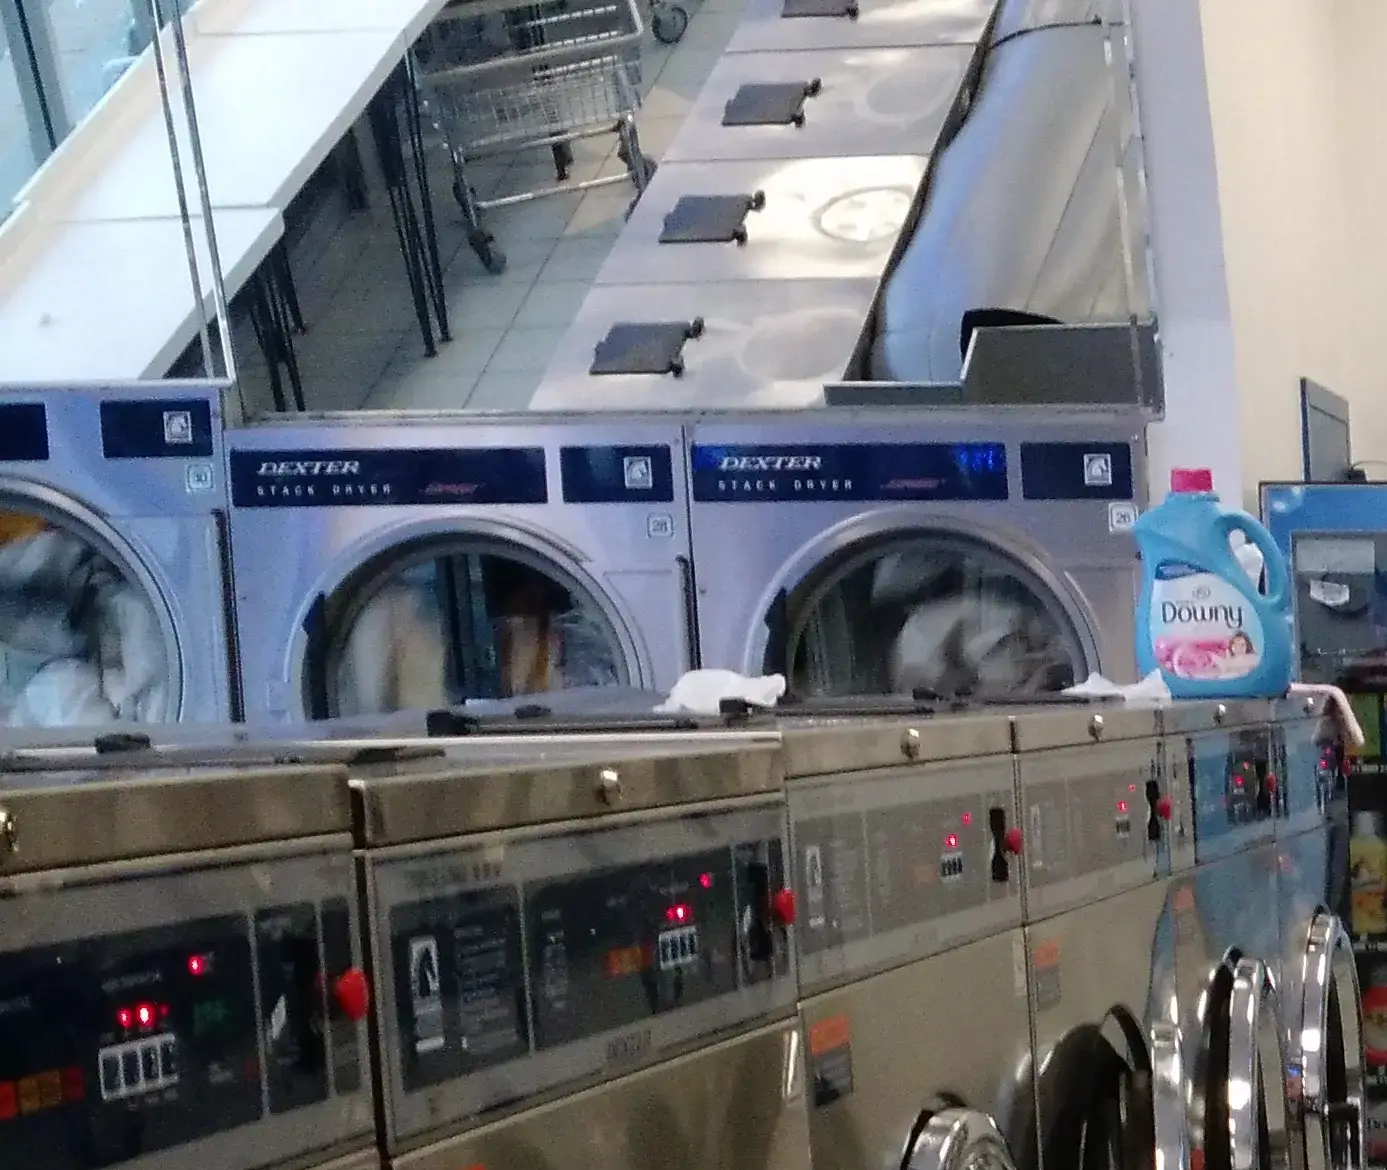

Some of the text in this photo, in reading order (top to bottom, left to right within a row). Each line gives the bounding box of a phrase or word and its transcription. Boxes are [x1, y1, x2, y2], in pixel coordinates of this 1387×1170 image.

[257, 460, 360, 476] DEXTER
[718, 455, 822, 471] DEXTER
[256, 484, 316, 496] STACK
[718, 479, 853, 491] STACK DRYER
[1161, 601, 1243, 630] Downy
